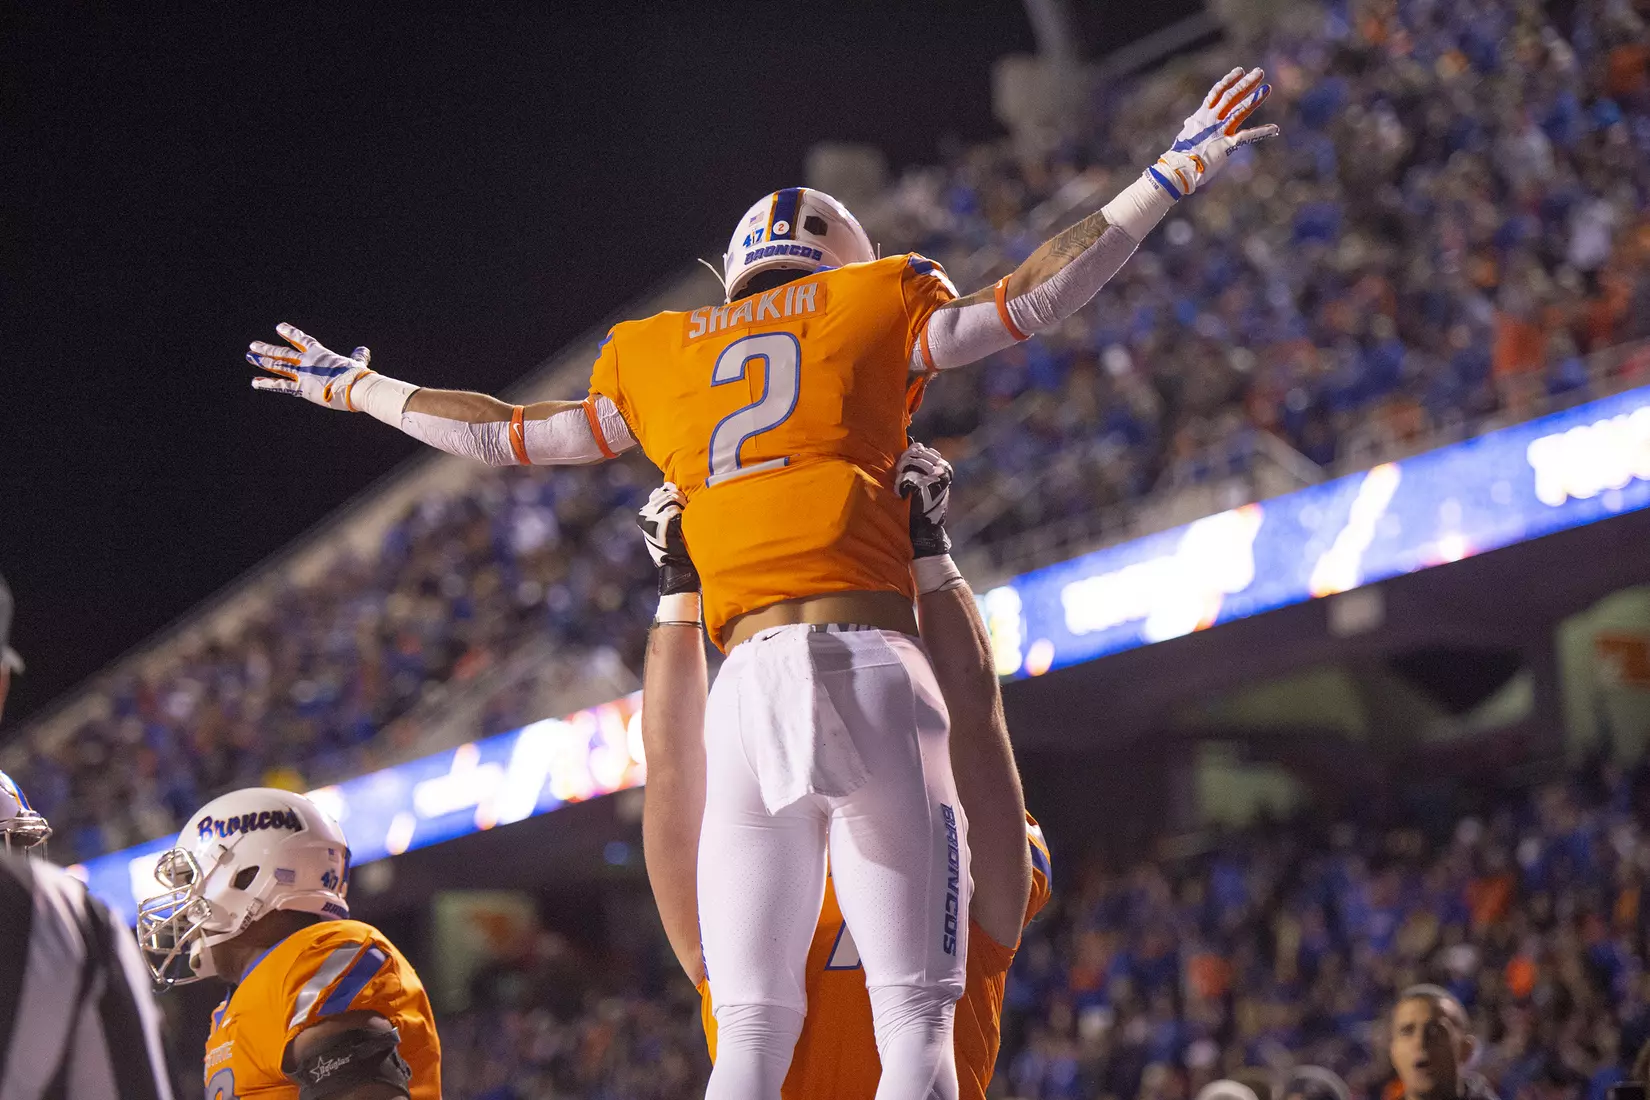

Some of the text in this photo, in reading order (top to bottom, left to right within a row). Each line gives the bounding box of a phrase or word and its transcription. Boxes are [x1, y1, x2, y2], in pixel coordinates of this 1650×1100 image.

[744, 244, 823, 266] BRONCOS
[778, 223, 785, 232] 2
[688, 282, 818, 339] SHAKIR
[705, 331, 801, 488] 2
[940, 802, 960, 957] BRONCOS
